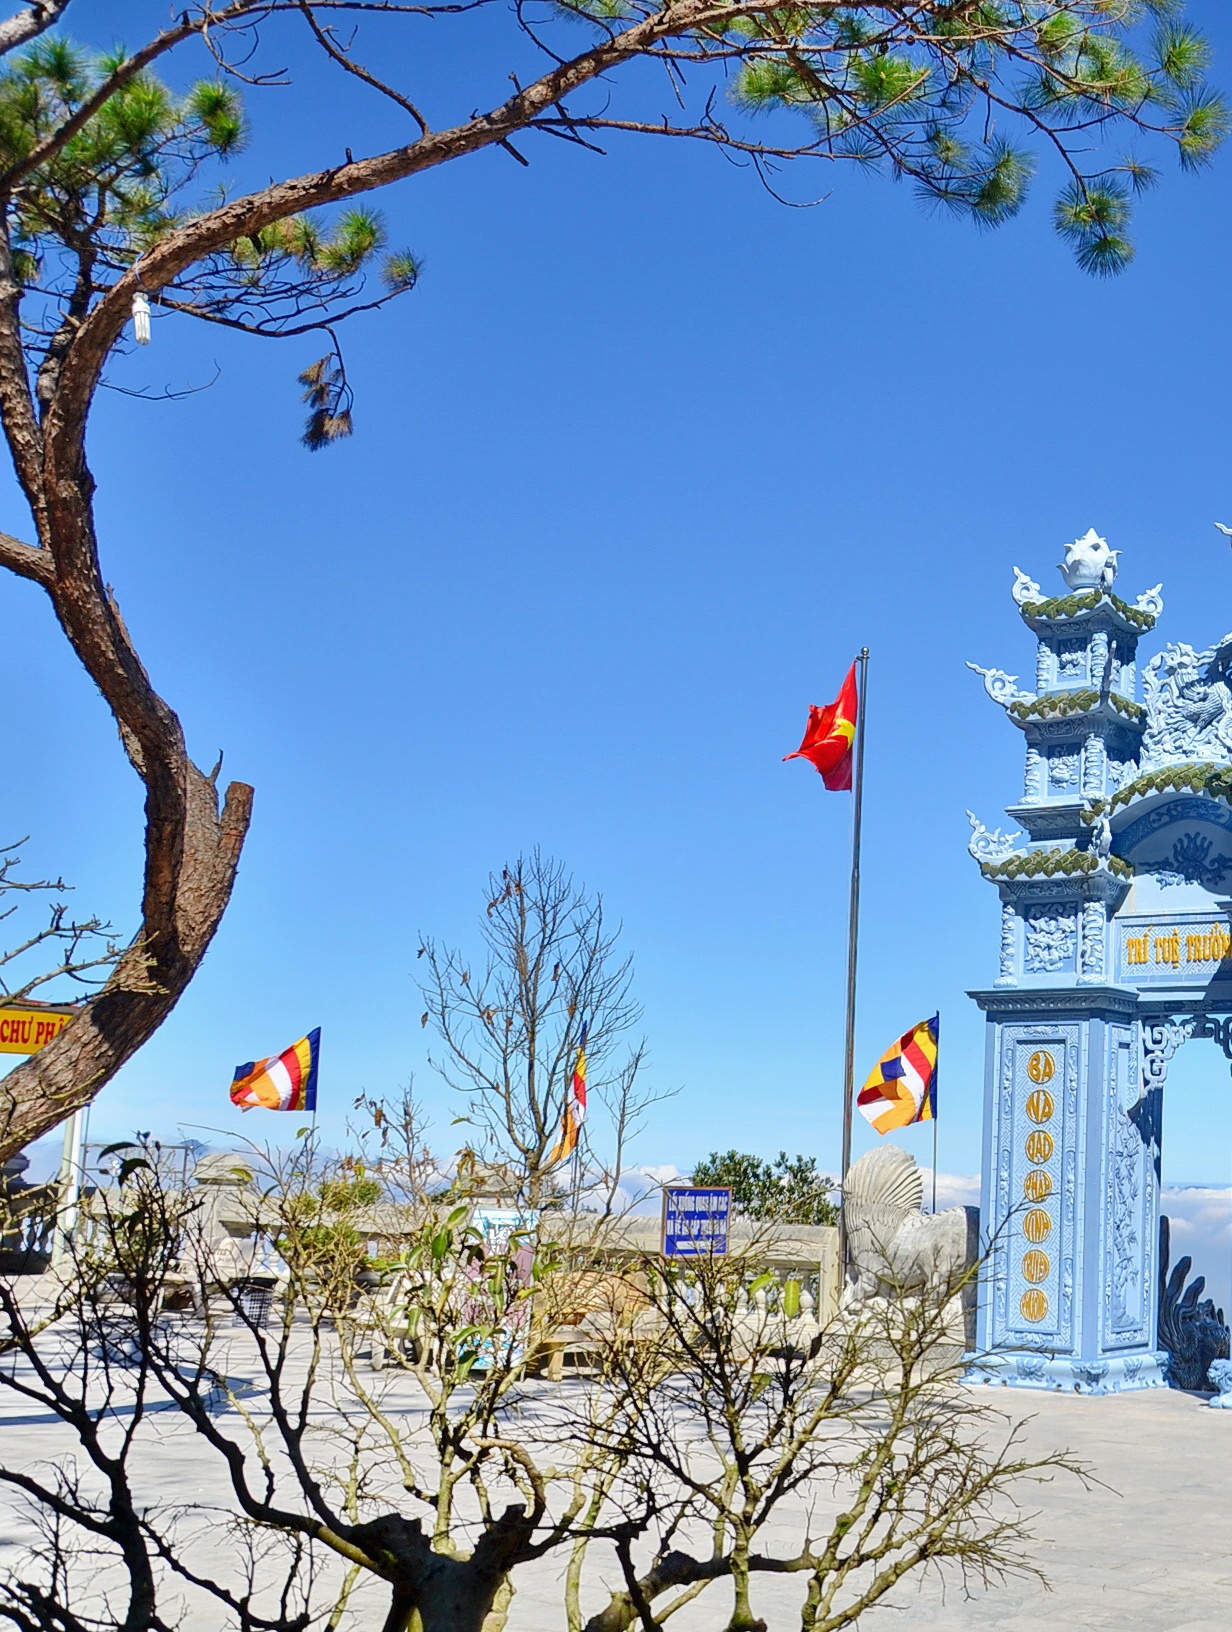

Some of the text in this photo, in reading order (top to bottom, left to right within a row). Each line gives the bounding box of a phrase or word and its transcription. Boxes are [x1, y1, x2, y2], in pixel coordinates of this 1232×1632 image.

[1126, 924, 1154, 965] TRÍ
[1154, 927, 1180, 970] TUỆ
[0, 1015, 65, 1046] CHƯ PH
